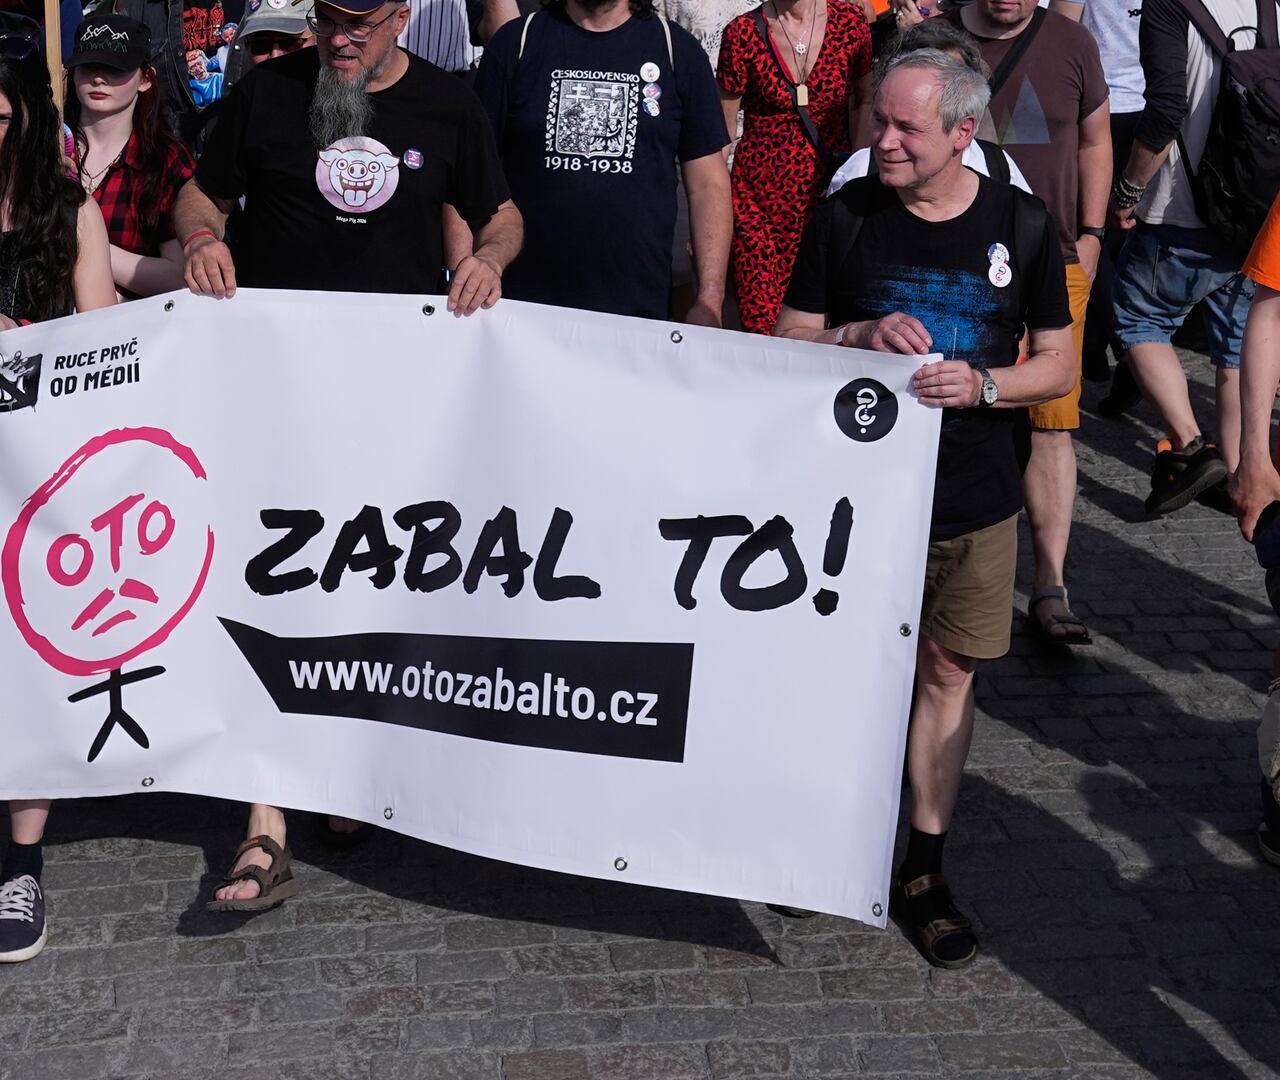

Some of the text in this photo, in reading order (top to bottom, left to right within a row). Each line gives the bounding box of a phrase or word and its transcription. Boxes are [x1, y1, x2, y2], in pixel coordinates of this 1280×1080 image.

[543, 156, 634, 174] 1918-1938
[49, 358, 141, 398] OD MÉDIÍ
[53, 337, 139, 370] RUCE PRYČ
[46, 492, 176, 587] OTO
[245, 496, 854, 617] ZABAL TO!
[288, 659, 659, 727] www.otozabalto.cz
